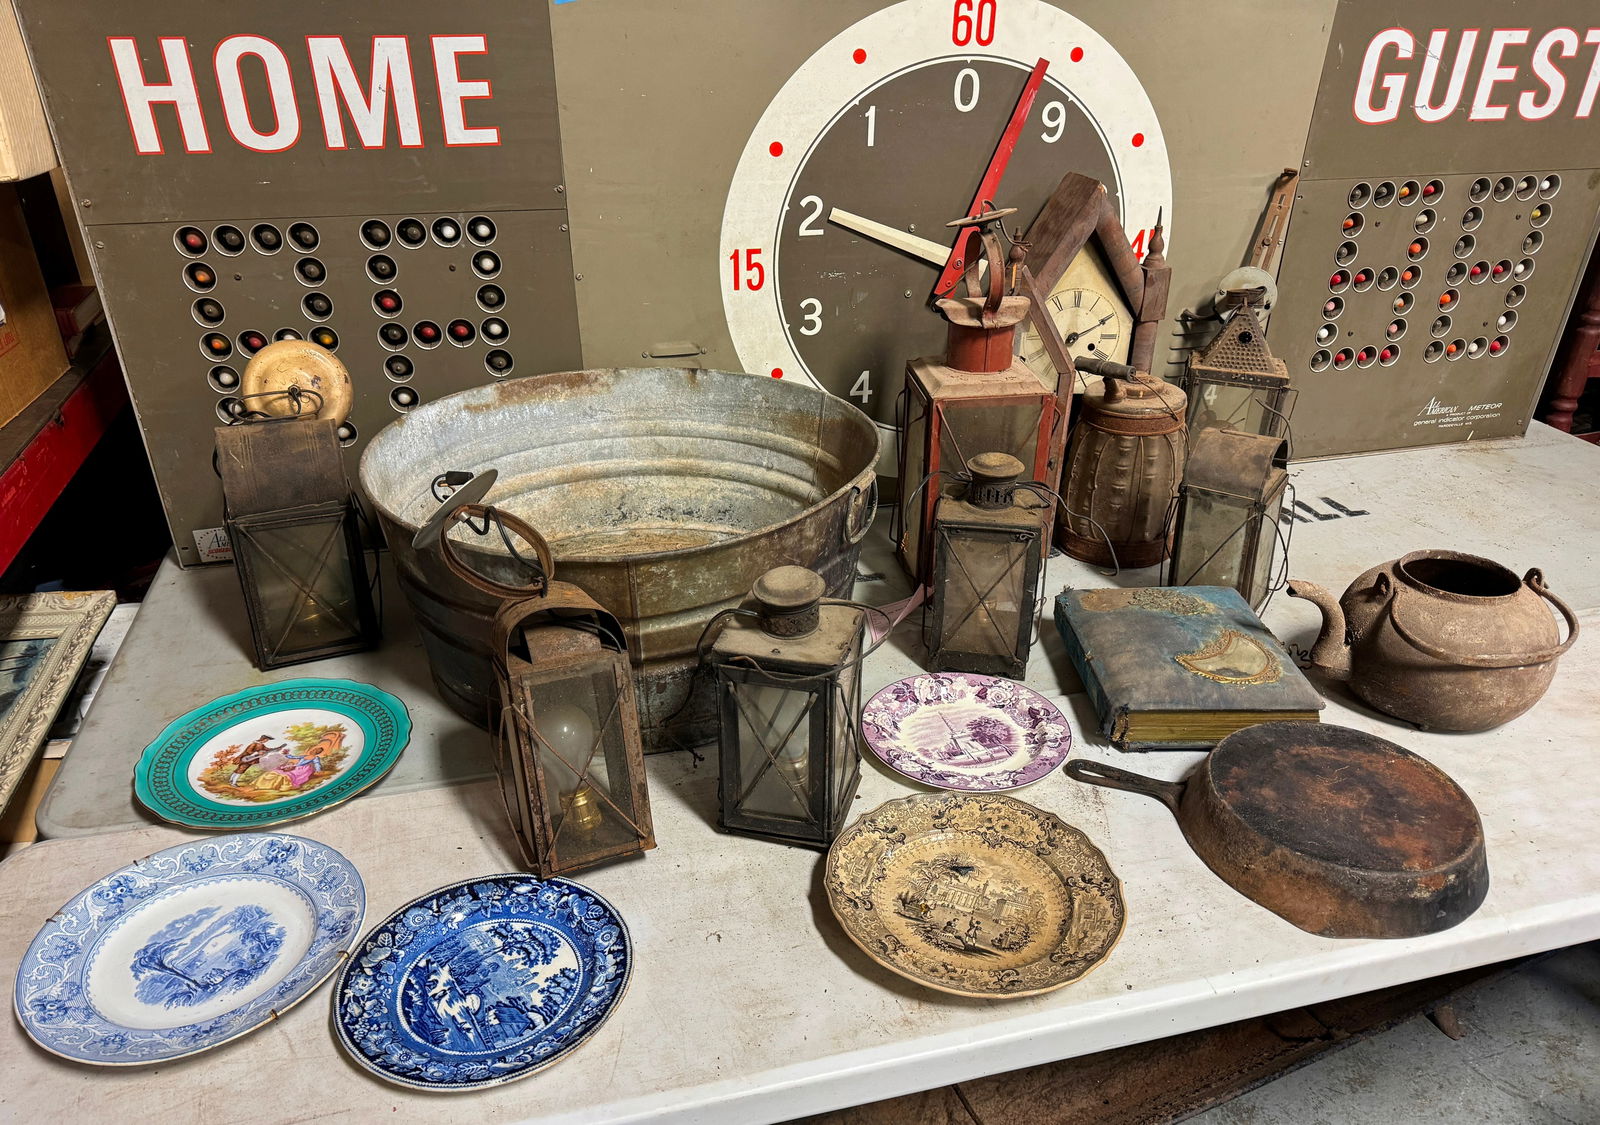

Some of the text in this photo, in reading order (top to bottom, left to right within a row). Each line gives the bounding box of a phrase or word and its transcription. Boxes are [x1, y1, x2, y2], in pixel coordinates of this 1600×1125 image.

[952, 0, 997, 47] 60
[106, 34, 502, 155] HOME
[954, 69, 980, 112] 0
[1352, 27, 1600, 126] GUEST
[865, 106, 876, 147] 1
[1041, 101, 1066, 143] 9
[799, 195, 824, 237] 2
[730, 248, 765, 292] 15
[799, 297, 823, 336] 3
[849, 370, 873, 404] 4
[1468, 402, 1503, 412] METEOR
[1413, 412, 1501, 427] general indicator corporation
